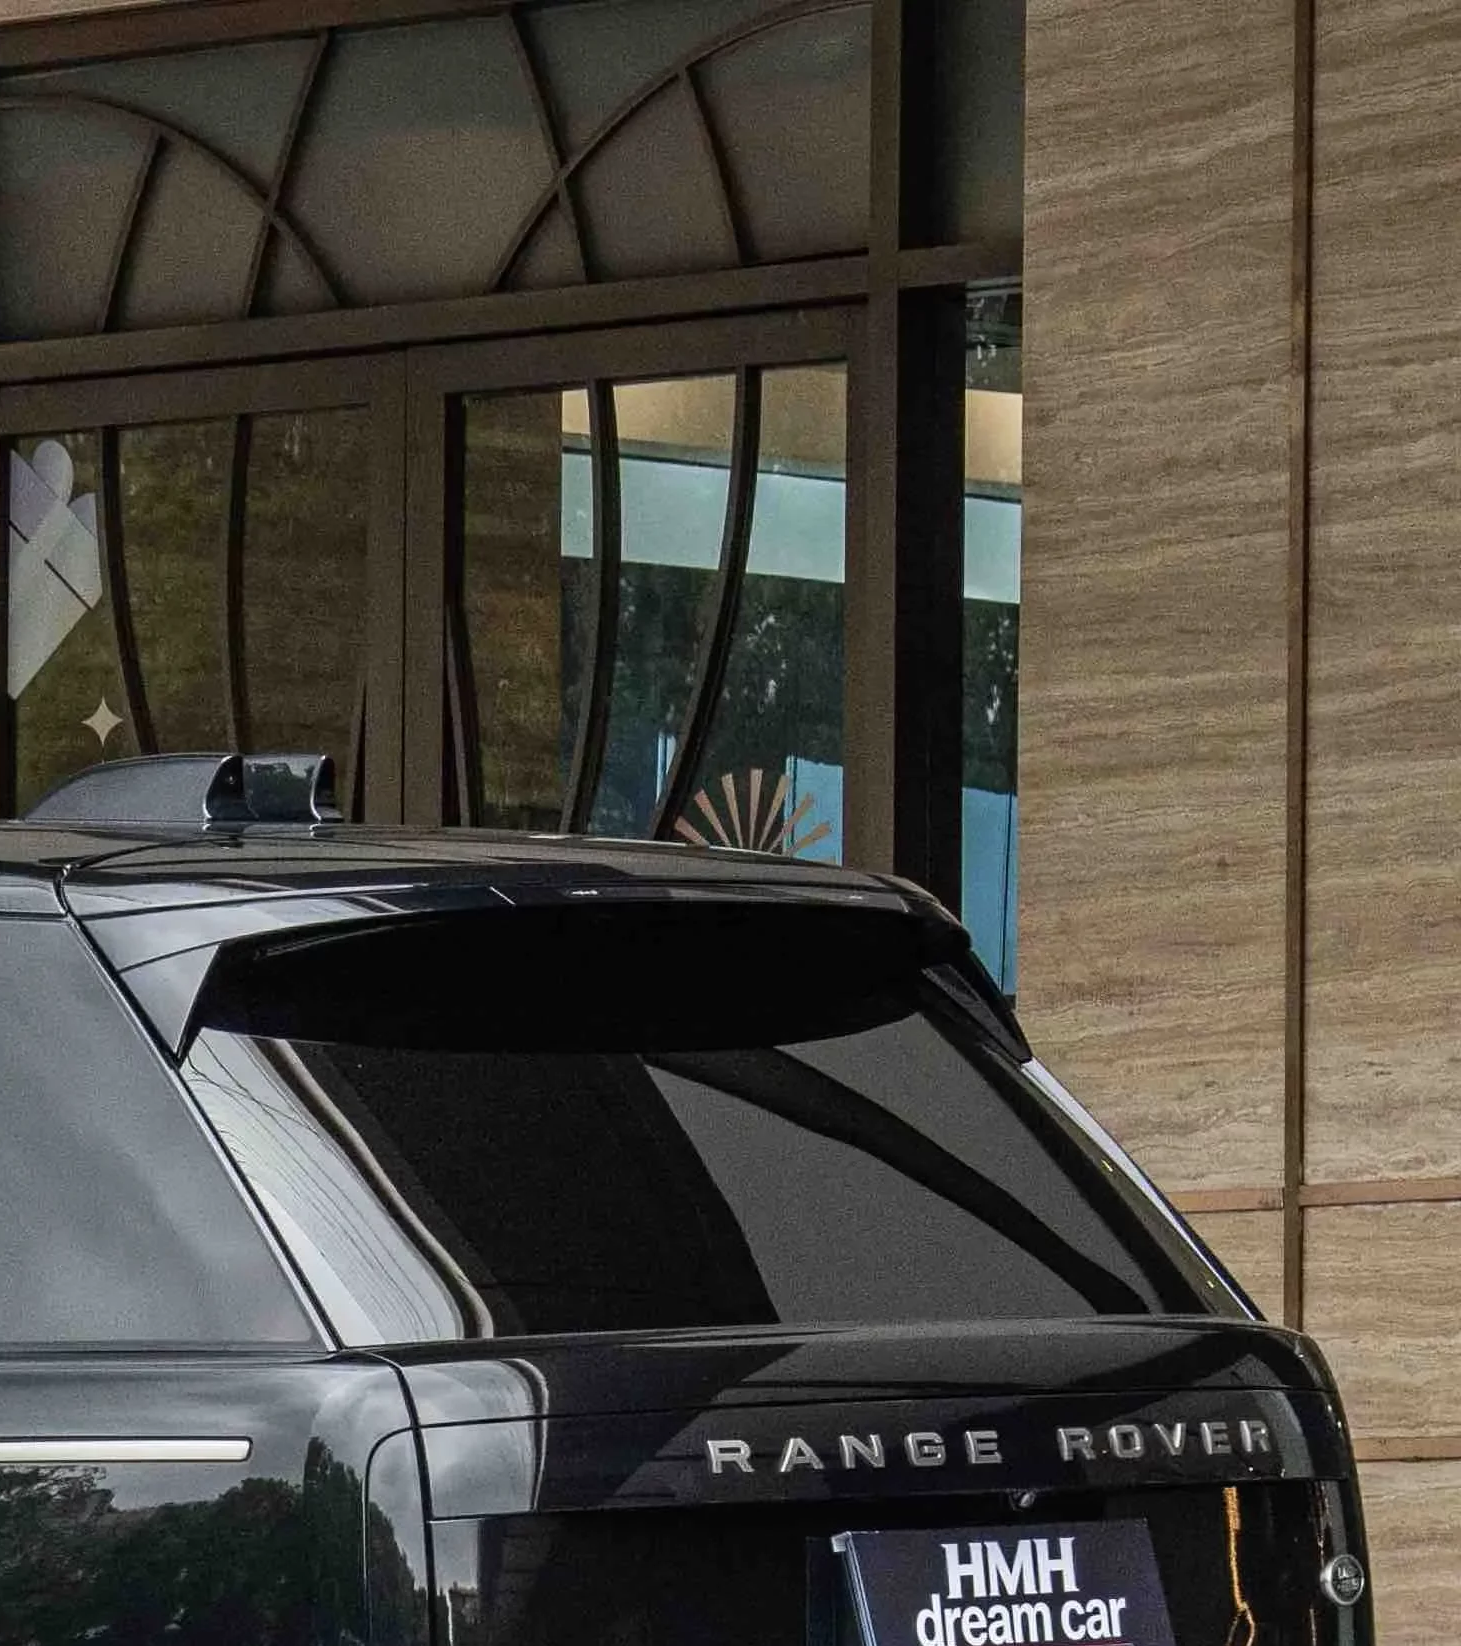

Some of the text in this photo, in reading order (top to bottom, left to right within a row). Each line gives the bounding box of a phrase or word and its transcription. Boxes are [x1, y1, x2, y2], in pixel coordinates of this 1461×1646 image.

[706, 1418, 1271, 1475] RANGE ROVER
[939, 1535, 1080, 1600] HMH
[1059, 1595, 1129, 1641] car
